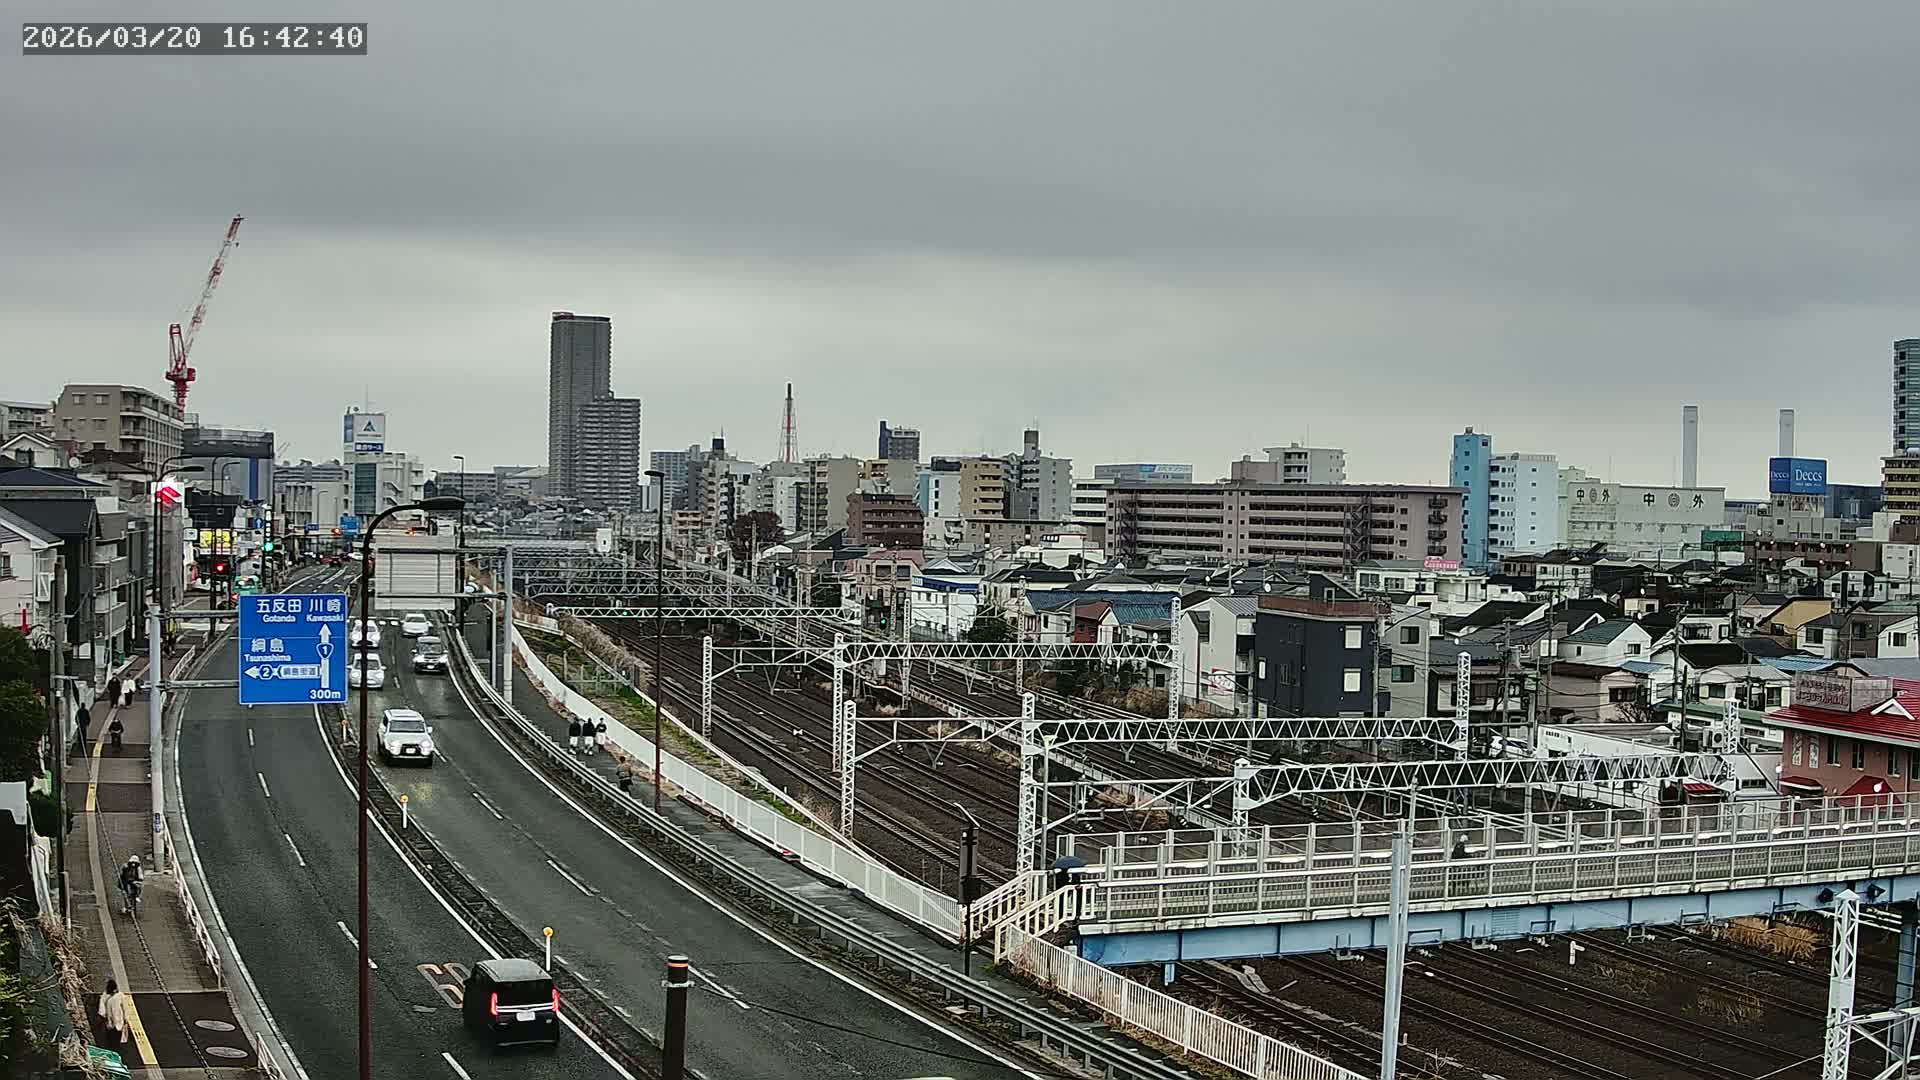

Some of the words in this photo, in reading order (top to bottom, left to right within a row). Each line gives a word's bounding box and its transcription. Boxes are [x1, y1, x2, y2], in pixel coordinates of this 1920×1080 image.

[1795, 469, 1823, 481] Deccs
[256, 598, 302, 613] 五反田
[306, 614, 344, 622] Kawasaki
[322, 645, 328, 655] 1
[262, 667, 270, 677] 2
[310, 690, 341, 699] 300m
